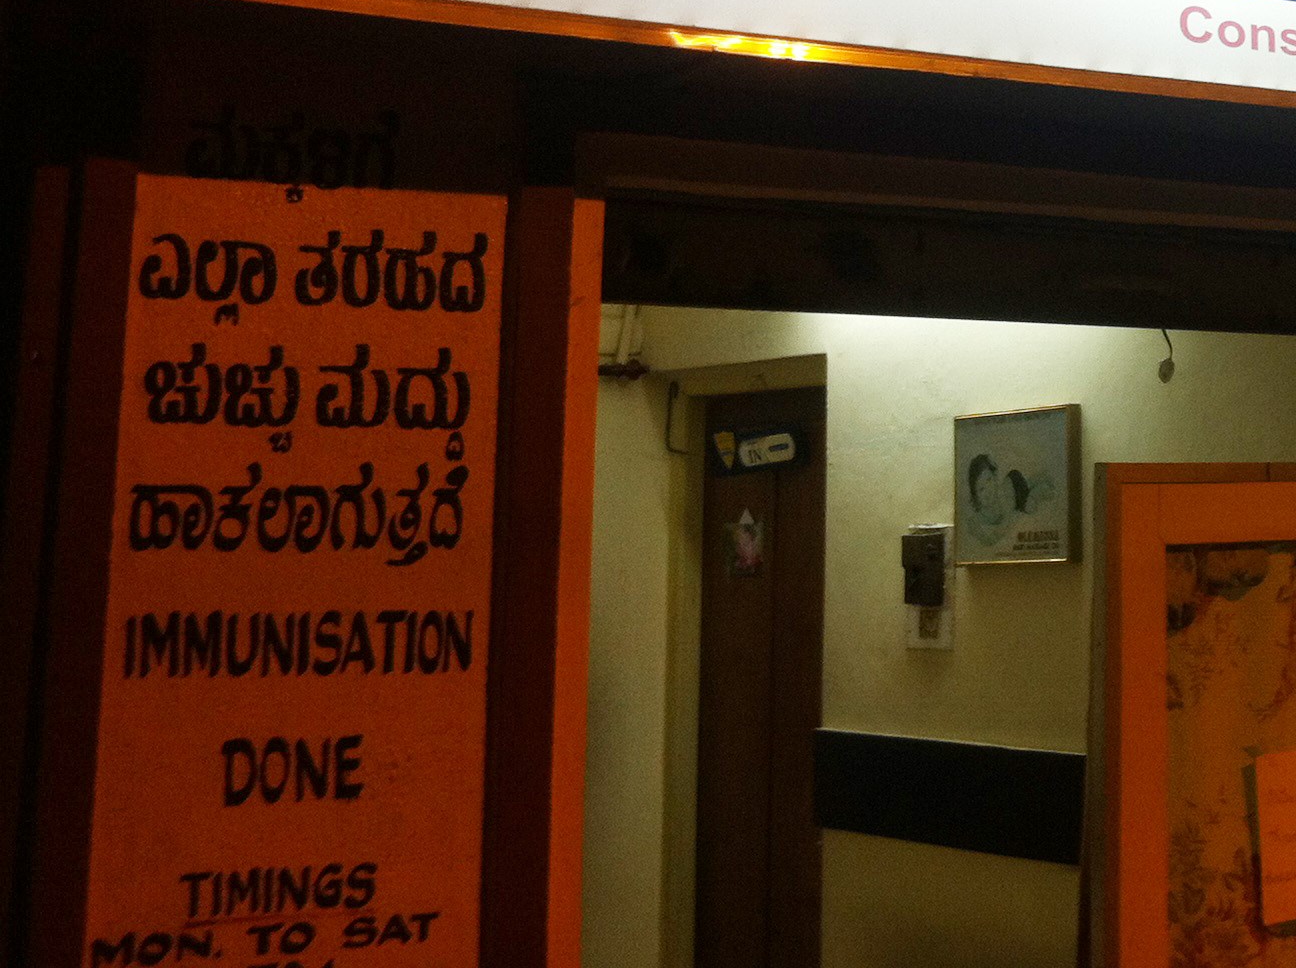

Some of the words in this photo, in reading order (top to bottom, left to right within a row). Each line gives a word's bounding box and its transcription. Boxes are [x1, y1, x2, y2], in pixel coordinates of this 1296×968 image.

[138, 233, 278, 326] ಎಲ್ಲಾ
[295, 229, 489, 313] ತರಹದ
[144, 342, 300, 453] ಚುಚ್ಚು
[123, 610, 474, 679] IMMUNISATION
[220, 734, 365, 807] DONE
[179, 863, 378, 919] TIMINGS
[90, 931, 222, 968] MON.
[246, 922, 314, 956] TO
[342, 911, 440, 950] SAT
